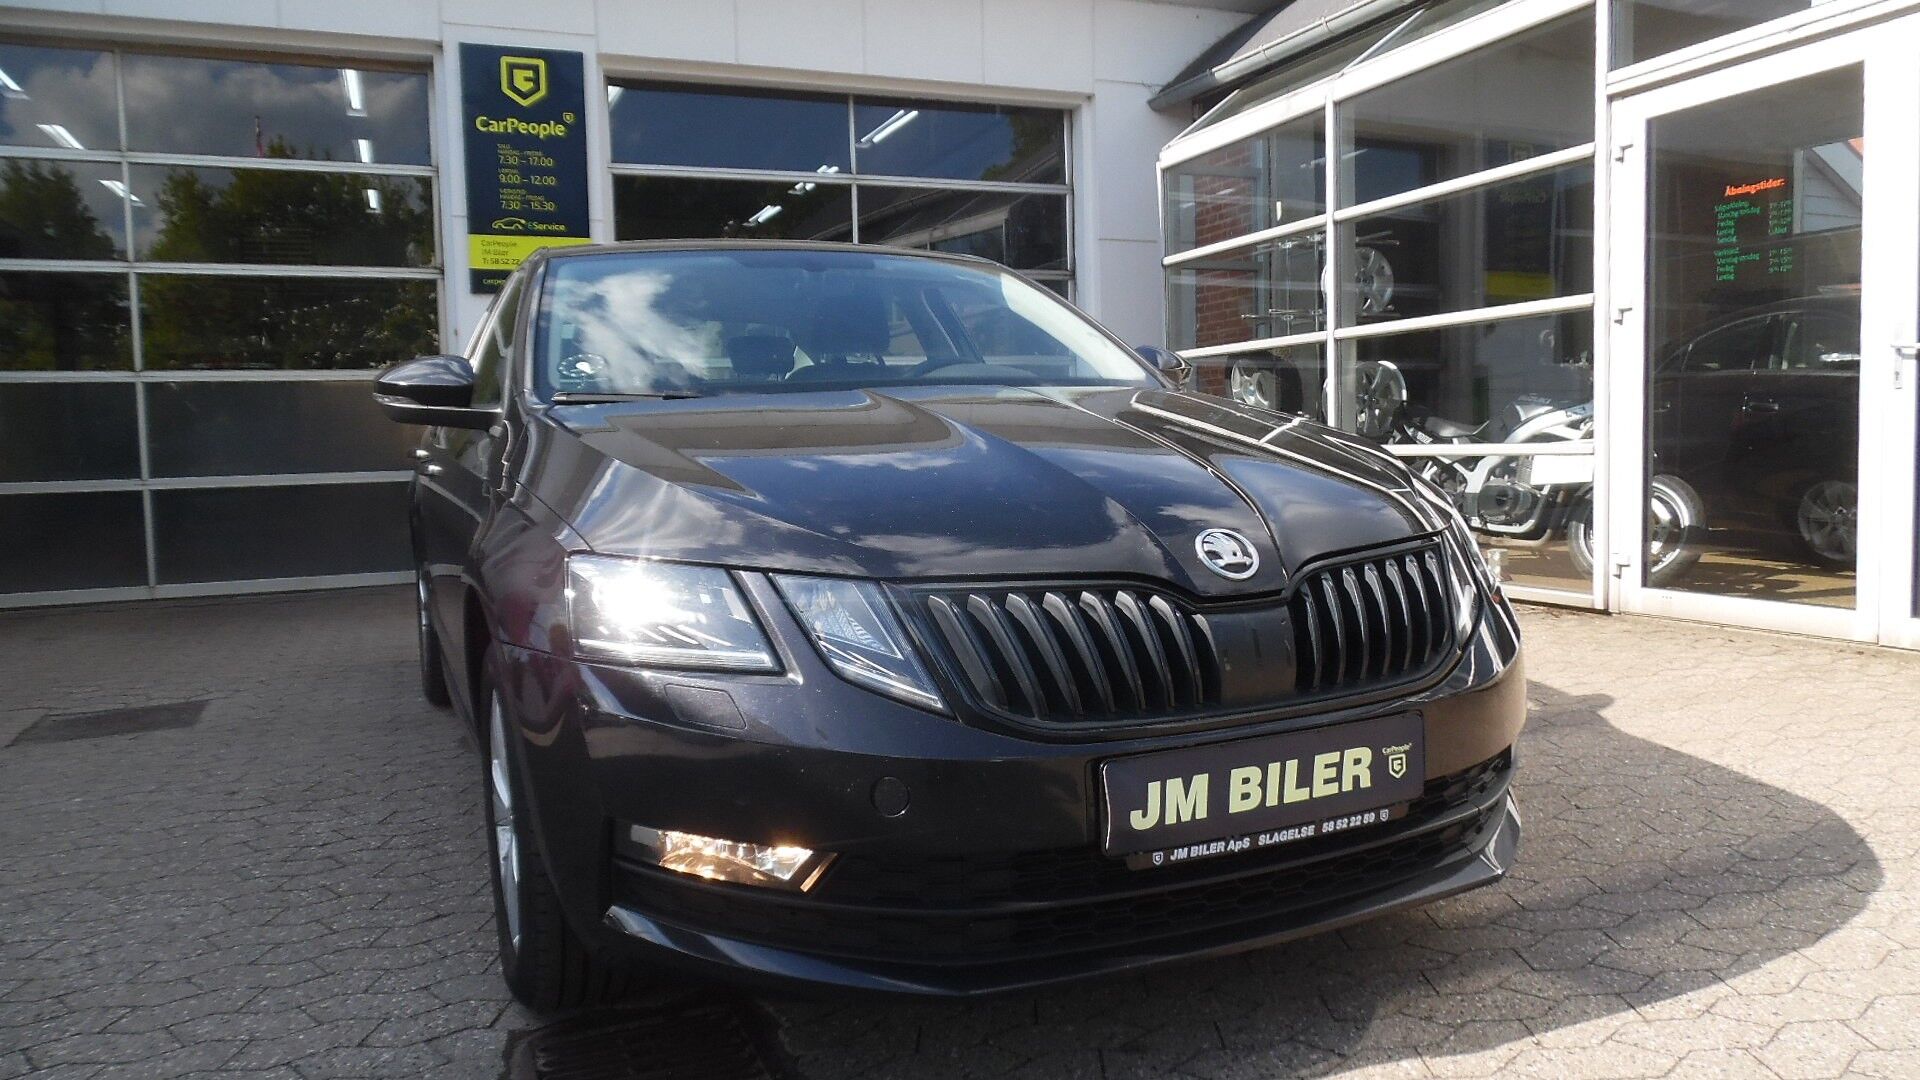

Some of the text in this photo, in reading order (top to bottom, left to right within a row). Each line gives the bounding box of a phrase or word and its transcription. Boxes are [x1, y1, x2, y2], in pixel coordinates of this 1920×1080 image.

[475, 116, 566, 139] CarPeople
[528, 157, 553, 167] 17.00
[499, 174, 520, 184] 9.00
[530, 175, 556, 185] 12.00
[500, 200, 520, 210] 7.30
[530, 201, 556, 211] 15.30
[1129, 746, 1373, 830] JM BILER
[1170, 847, 1189, 860] JM
[1190, 841, 1225, 857] BILER
[1227, 837, 1250, 852] ApS
[1258, 824, 1315, 845] SLAGELSE
[1322, 821, 1335, 832] 58
[1336, 818, 1348, 830] 52
[1349, 815, 1362, 827] 22
